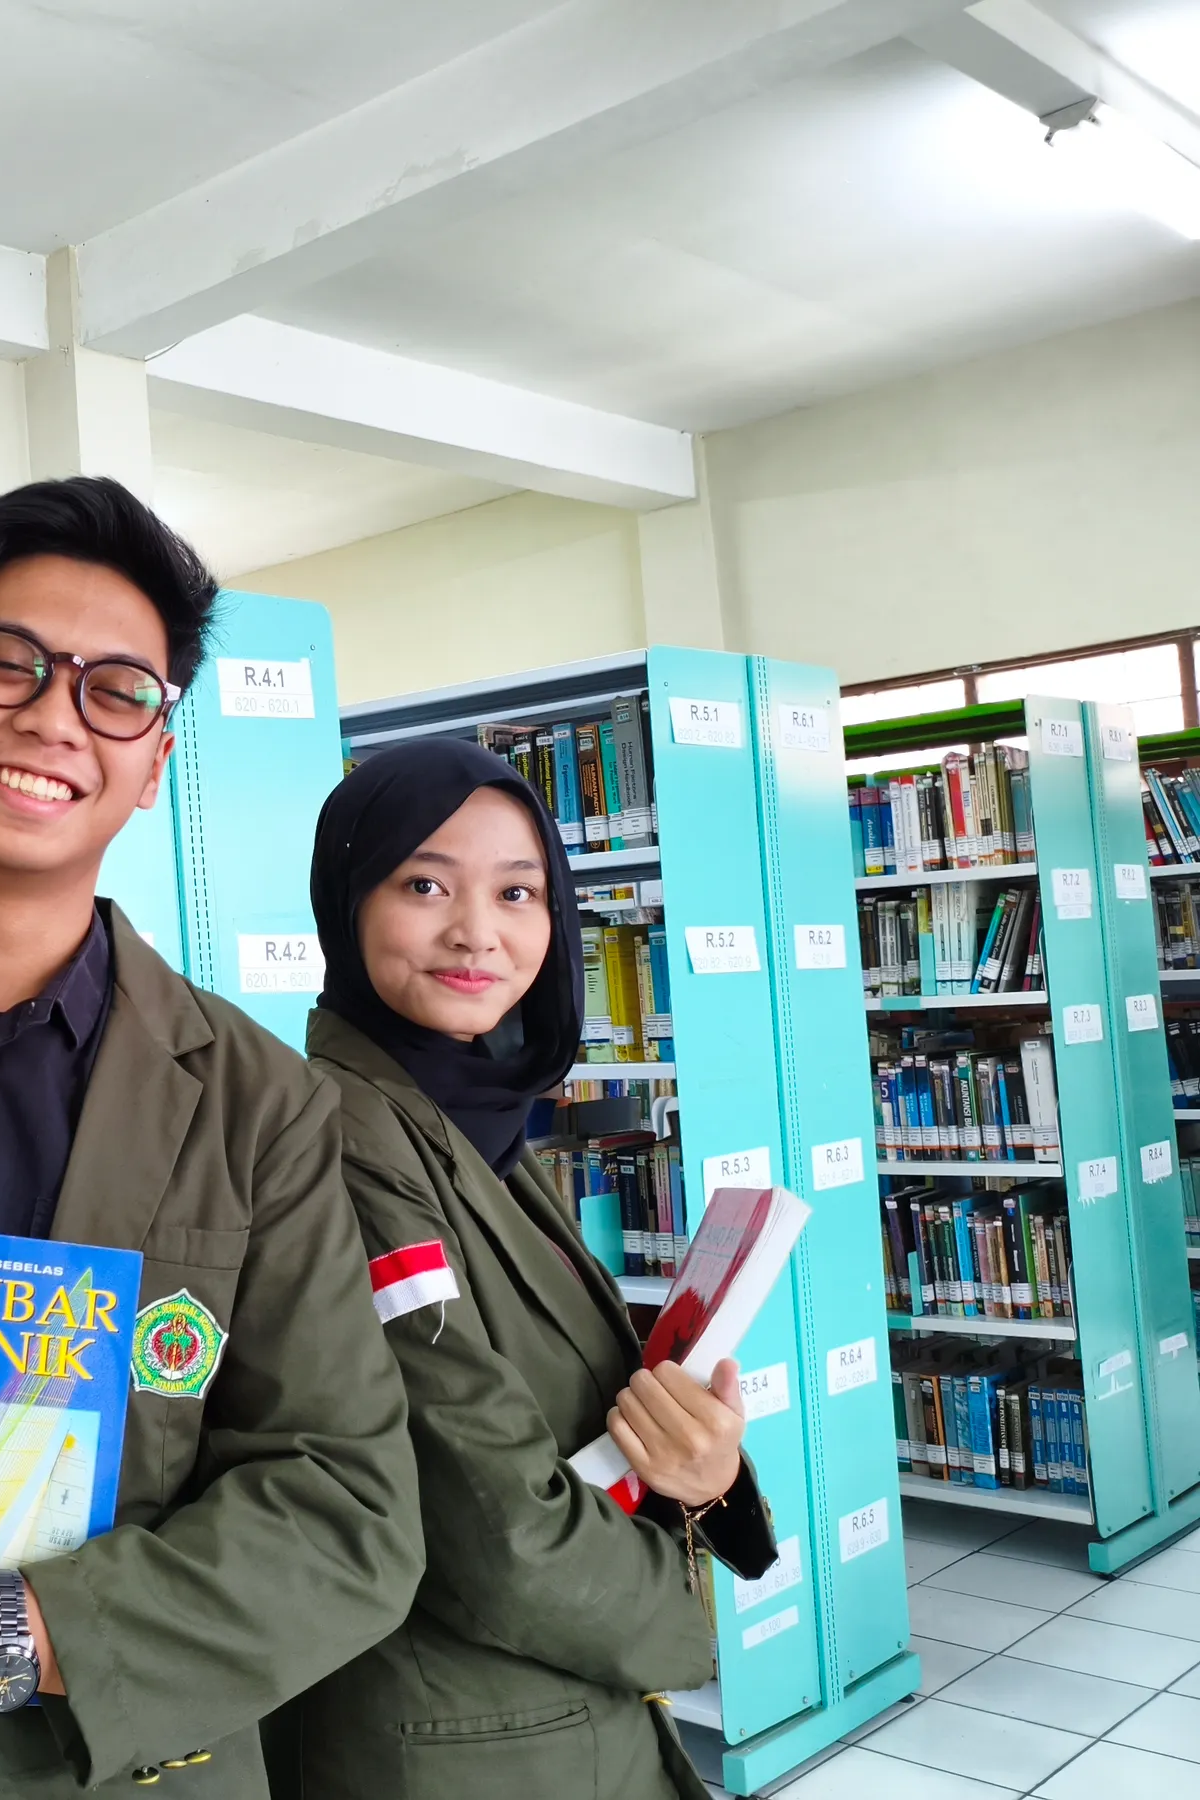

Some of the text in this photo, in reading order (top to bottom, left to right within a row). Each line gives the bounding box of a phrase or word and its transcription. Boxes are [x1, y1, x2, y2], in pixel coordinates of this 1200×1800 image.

[244, 666, 285, 688] R.4.1
[235, 696, 257, 712] 620
[268, 697, 300, 714] 620.1
[690, 704, 719, 722] R.5.1
[792, 711, 814, 728] R.6.1
[1050, 723, 1068, 738] R.7.1
[562, 764, 571, 798] Ergonomics
[590, 763, 598, 792] HUMAN
[1062, 873, 1081, 886] R.7.2
[706, 932, 735, 948] R.5.2
[809, 930, 832, 945] R.6.2
[265, 940, 307, 962] R.4.2
[246, 972, 278, 988] 620.1
[1073, 1009, 1091, 1023] R.7.3
[881, 1081, 889, 1098] 5
[960, 1079, 972, 1117] AKUNTANSI
[826, 1145, 849, 1164] R.6.3
[1148, 1146, 1163, 1161] R.8.4
[721, 1156, 750, 1177] R.5.3
[1088, 1163, 1106, 1178] R.7.4
[840, 1346, 862, 1367] R.6.4
[740, 1373, 769, 1396] R.5.4
[852, 1508, 875, 1532] R.6.5
